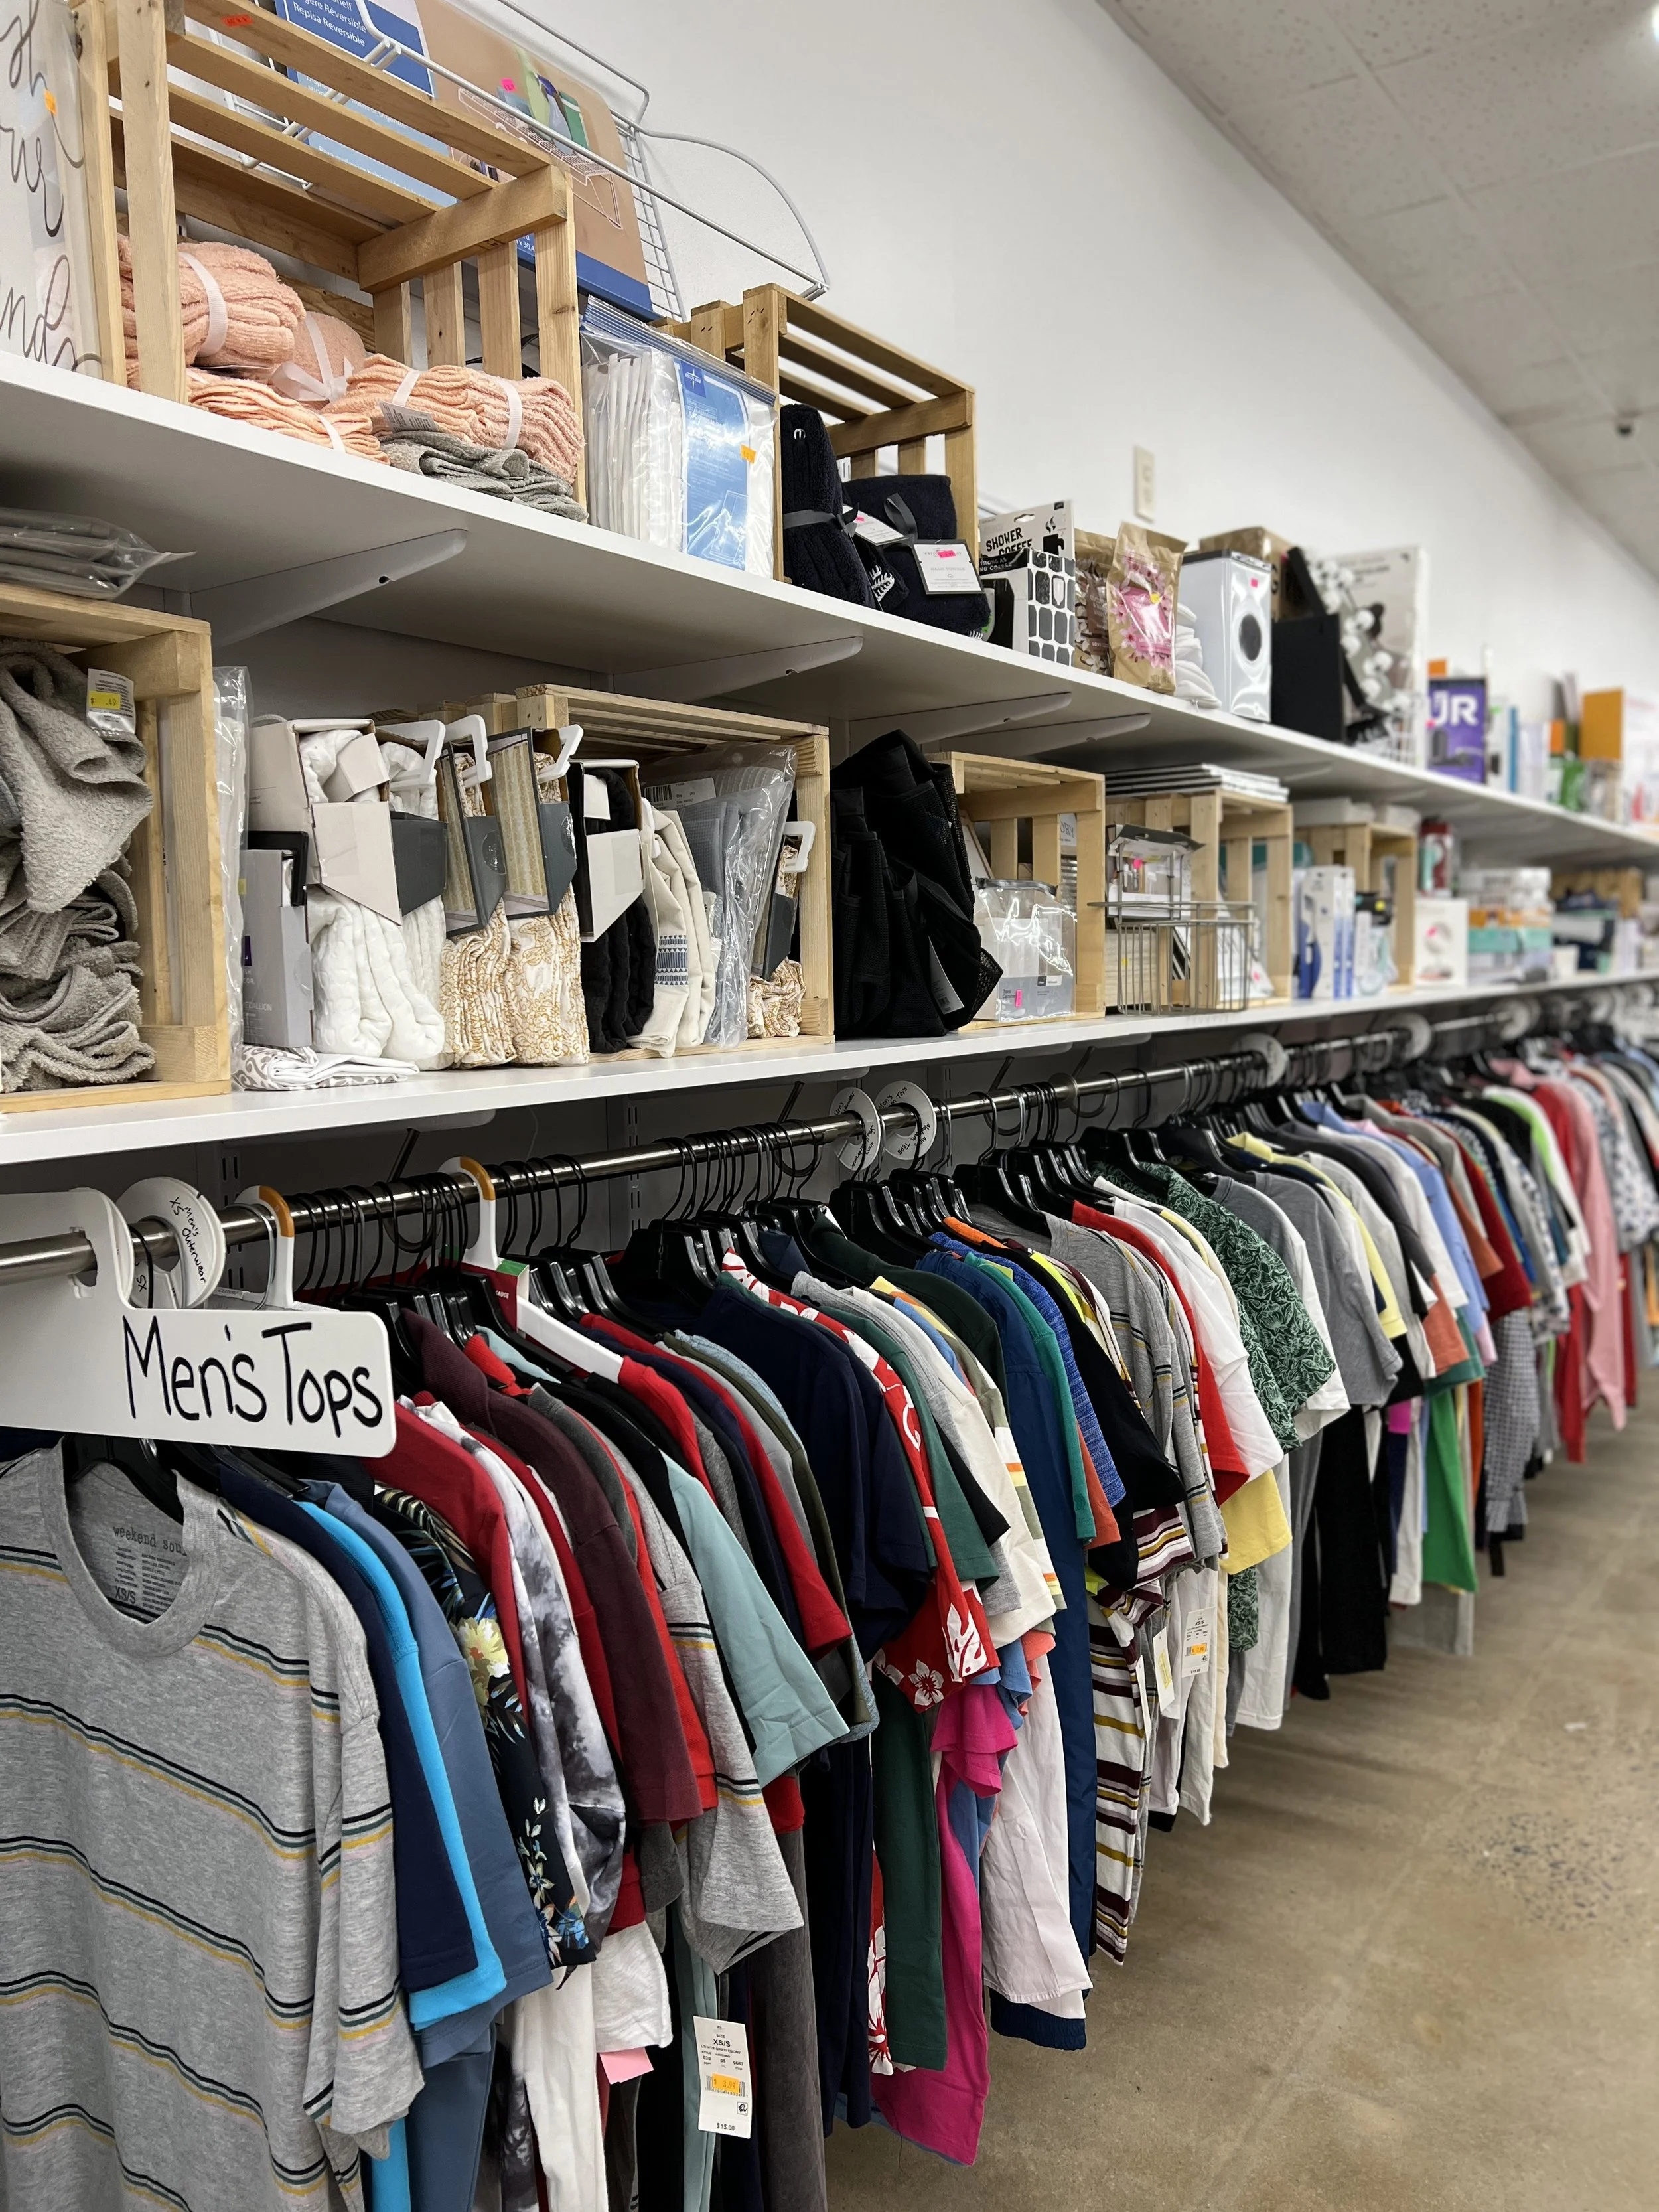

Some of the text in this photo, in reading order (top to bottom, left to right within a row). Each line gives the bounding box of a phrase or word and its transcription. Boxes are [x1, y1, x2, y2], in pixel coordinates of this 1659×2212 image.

[293, 1, 366, 47] Repisa Reversible
[324, 3, 367, 33] Réversible
[985, 527, 1023, 552] SHOWER
[90, 696, 94, 705] $
[106, 698, 117, 706] .49
[244, 1001, 272, 1011] EDALLION
[896, 1086, 908, 1099] Tops
[169, 1197, 184, 1216] XS
[184, 1206, 199, 1237] Men's
[182, 1228, 206, 1284] Outerwear
[136, 1274, 147, 1293] XS
[122, 1315, 383, 1438] Men's Tops
[113, 1526, 157, 1548] weekend
[115, 1586, 136, 1605] XS/S
[713, 2038, 731, 2047] XS/S
[723, 2080, 736, 2089] 3.99
[717, 2122, 735, 2132] $15.00
